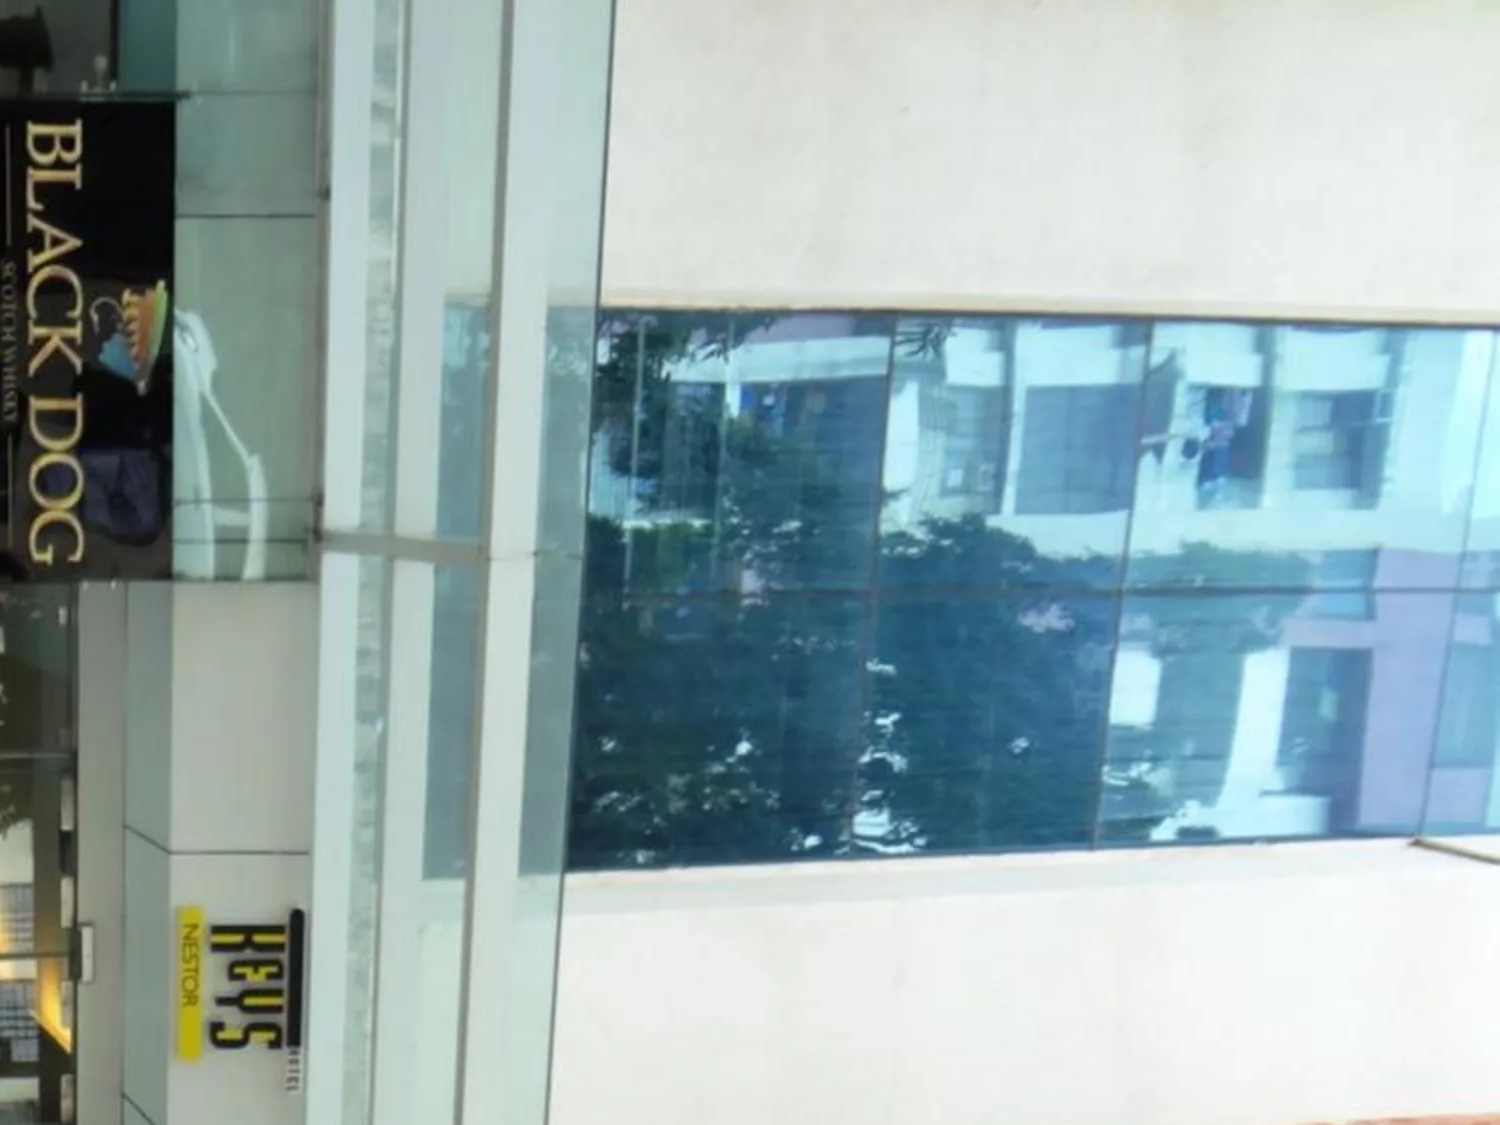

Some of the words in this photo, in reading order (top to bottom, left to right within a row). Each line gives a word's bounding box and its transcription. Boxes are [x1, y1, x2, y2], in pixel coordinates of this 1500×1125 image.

[25, 119, 83, 376] BLACK
[0, 260, 19, 342] SCOTCH
[1, 345, 20, 424] WHISKY
[27, 393, 84, 566] DOG
[181, 923, 199, 1008] NESTOR
